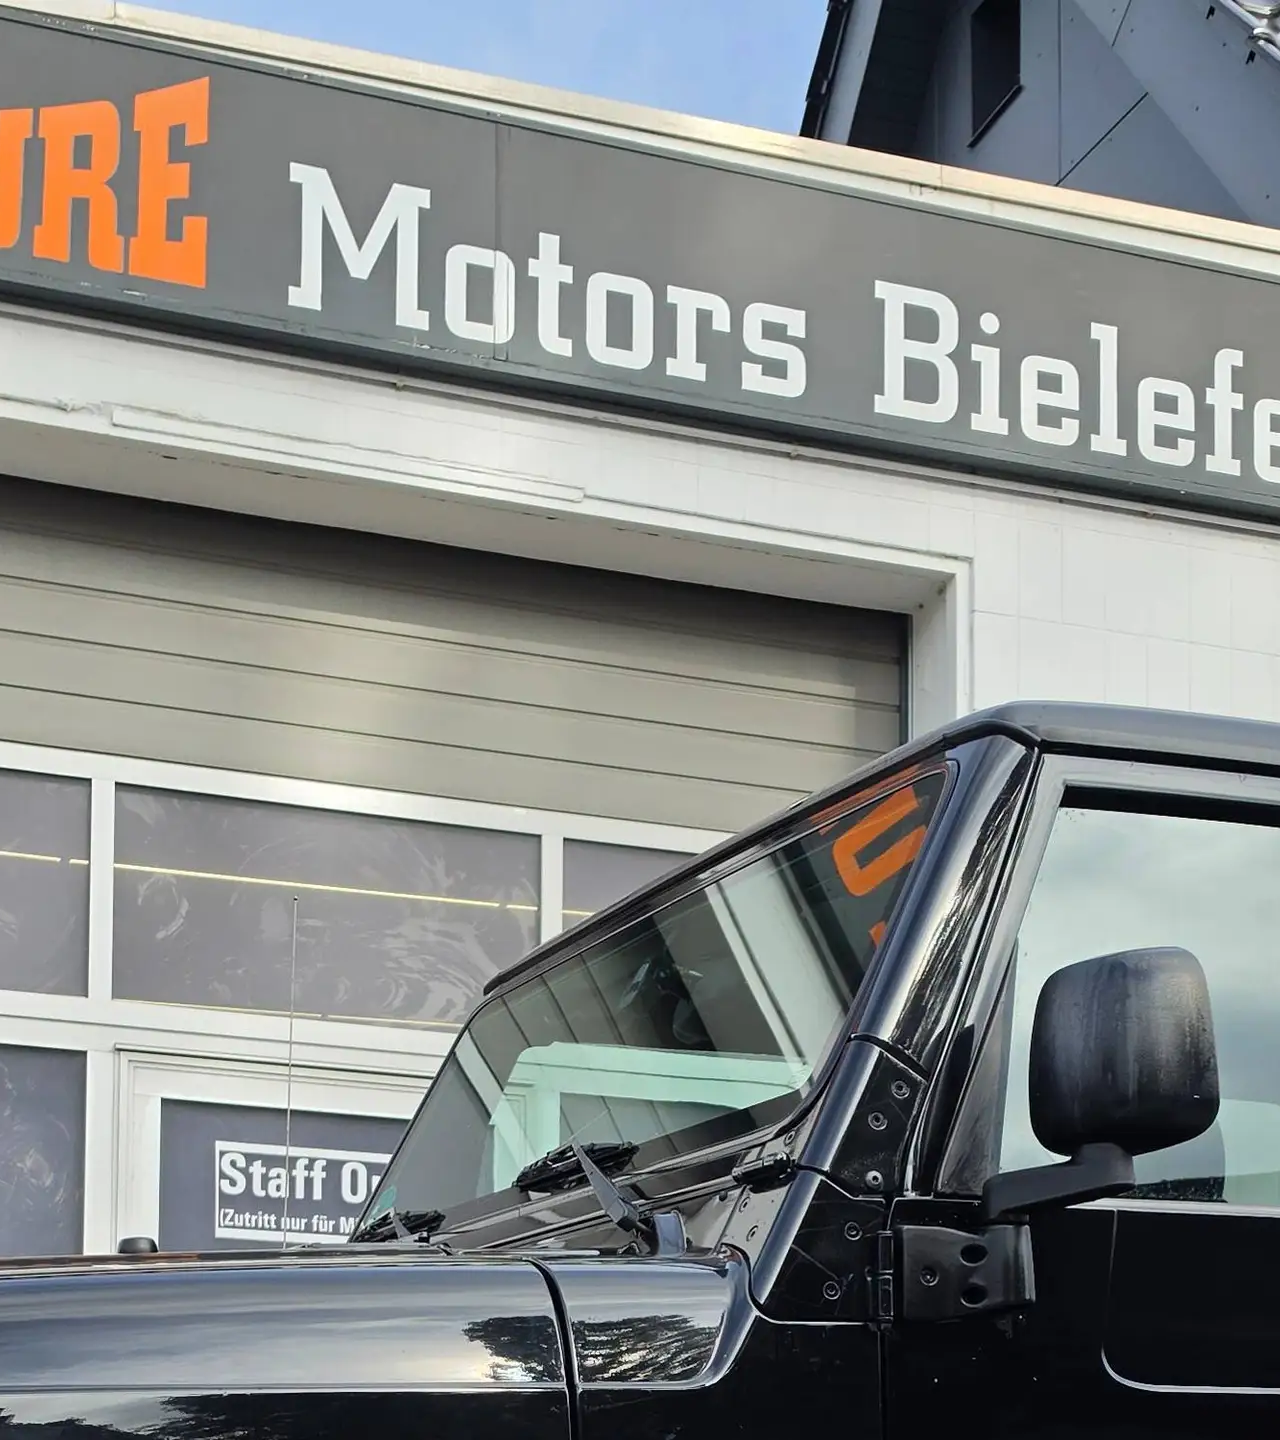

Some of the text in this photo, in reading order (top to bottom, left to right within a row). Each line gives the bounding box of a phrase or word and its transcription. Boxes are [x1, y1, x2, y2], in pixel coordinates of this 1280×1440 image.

[287, 162, 808, 399] Motors
[220, 1151, 327, 1201] Staff
[220, 1208, 277, 1228] (Zutritt
[281, 1213, 308, 1232] nur
[312, 1214, 336, 1233] für
